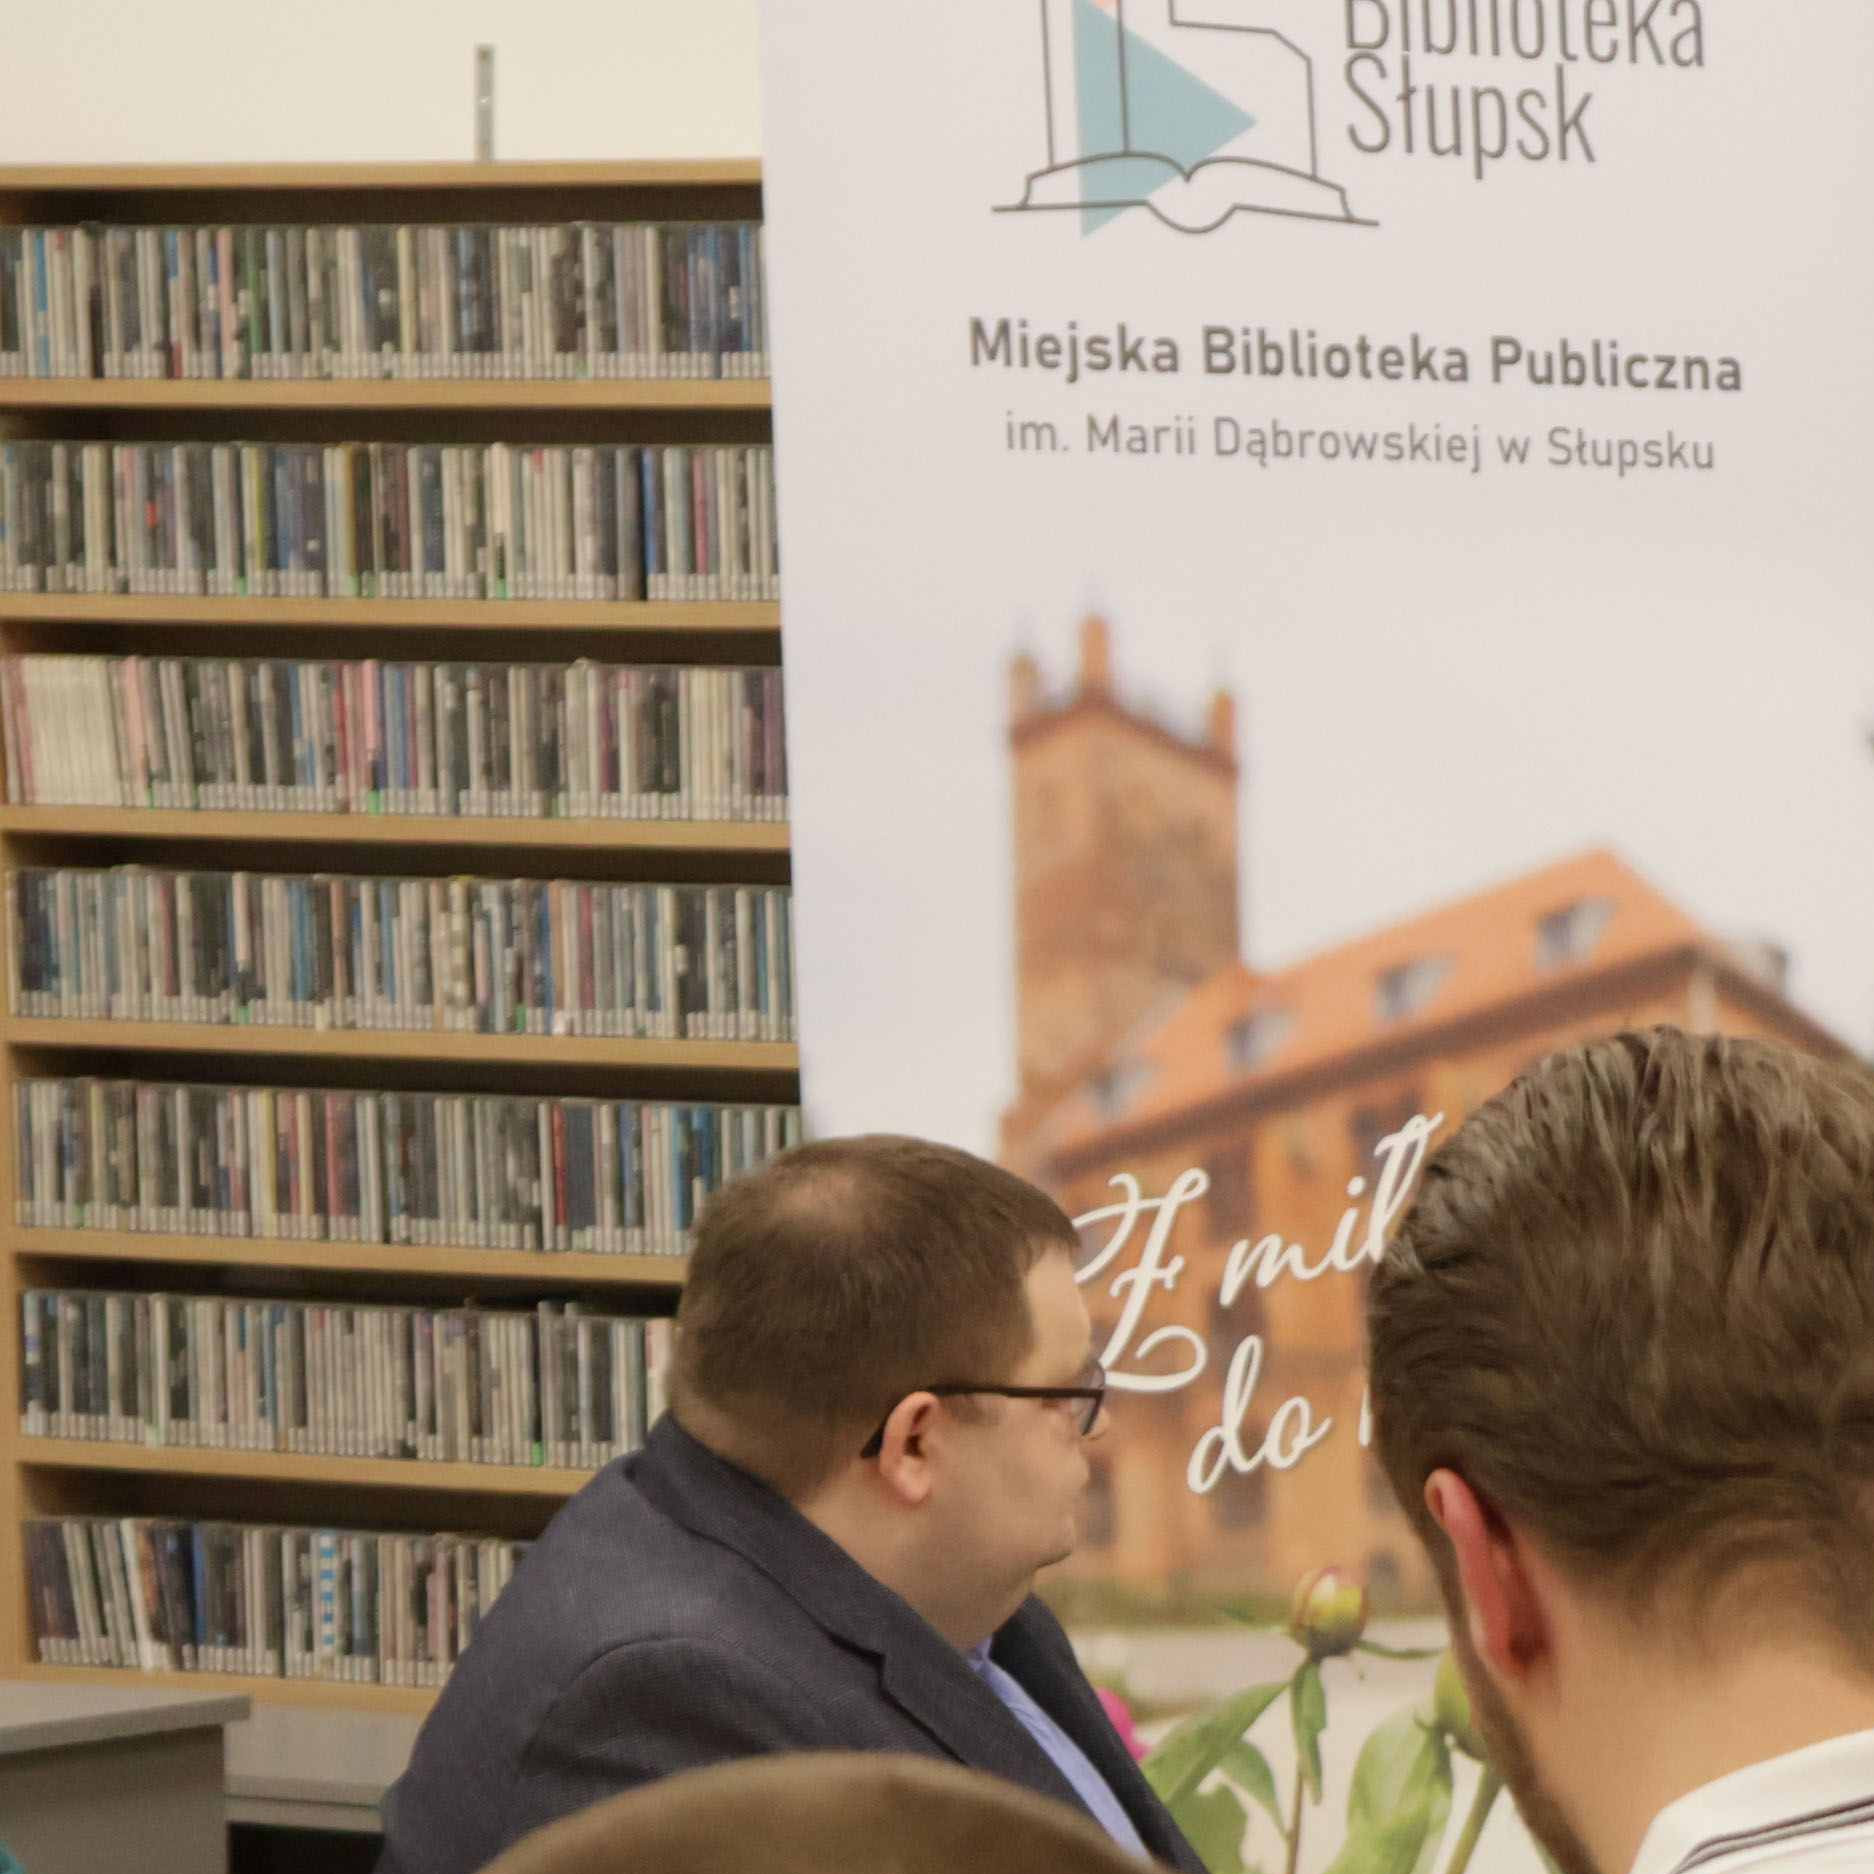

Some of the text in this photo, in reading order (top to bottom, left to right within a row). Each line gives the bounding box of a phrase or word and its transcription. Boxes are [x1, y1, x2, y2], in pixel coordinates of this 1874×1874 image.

[1344, 52, 1597, 180] Słupsk
[968, 316, 1743, 392] Miejska Biblioteka Publiczna
[1005, 411, 1715, 478] im. Marii Dąbrowskiej w Słupsku
[1186, 1334, 1332, 1494] do
